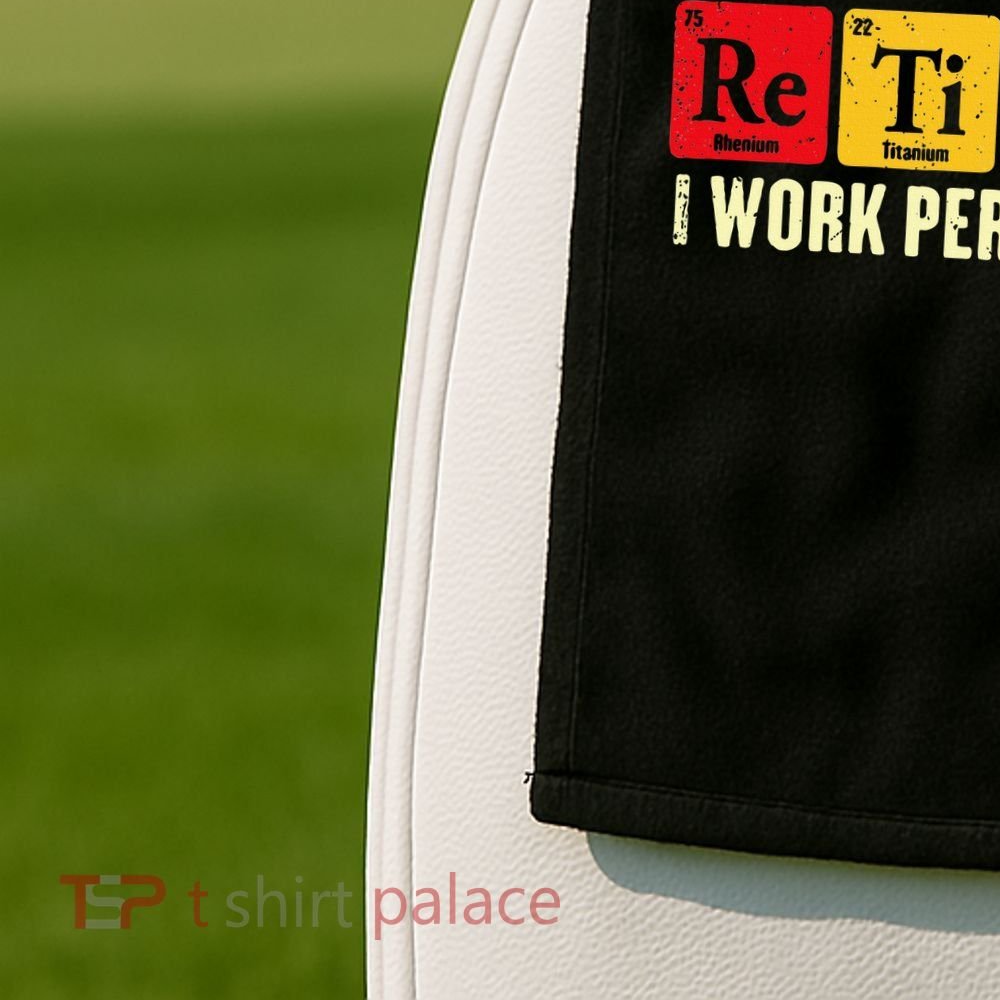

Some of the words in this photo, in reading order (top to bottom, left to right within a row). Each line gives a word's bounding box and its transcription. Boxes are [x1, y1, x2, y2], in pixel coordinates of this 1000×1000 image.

[684, 9, 704, 28] 75
[853, 18, 873, 36] 22
[692, 37, 807, 127] Re
[871, 43, 966, 136] Ti
[713, 133, 780, 154] Rhenium
[882, 139, 949, 163] Titanium
[672, 173, 690, 246] I
[710, 175, 887, 256] WORK
